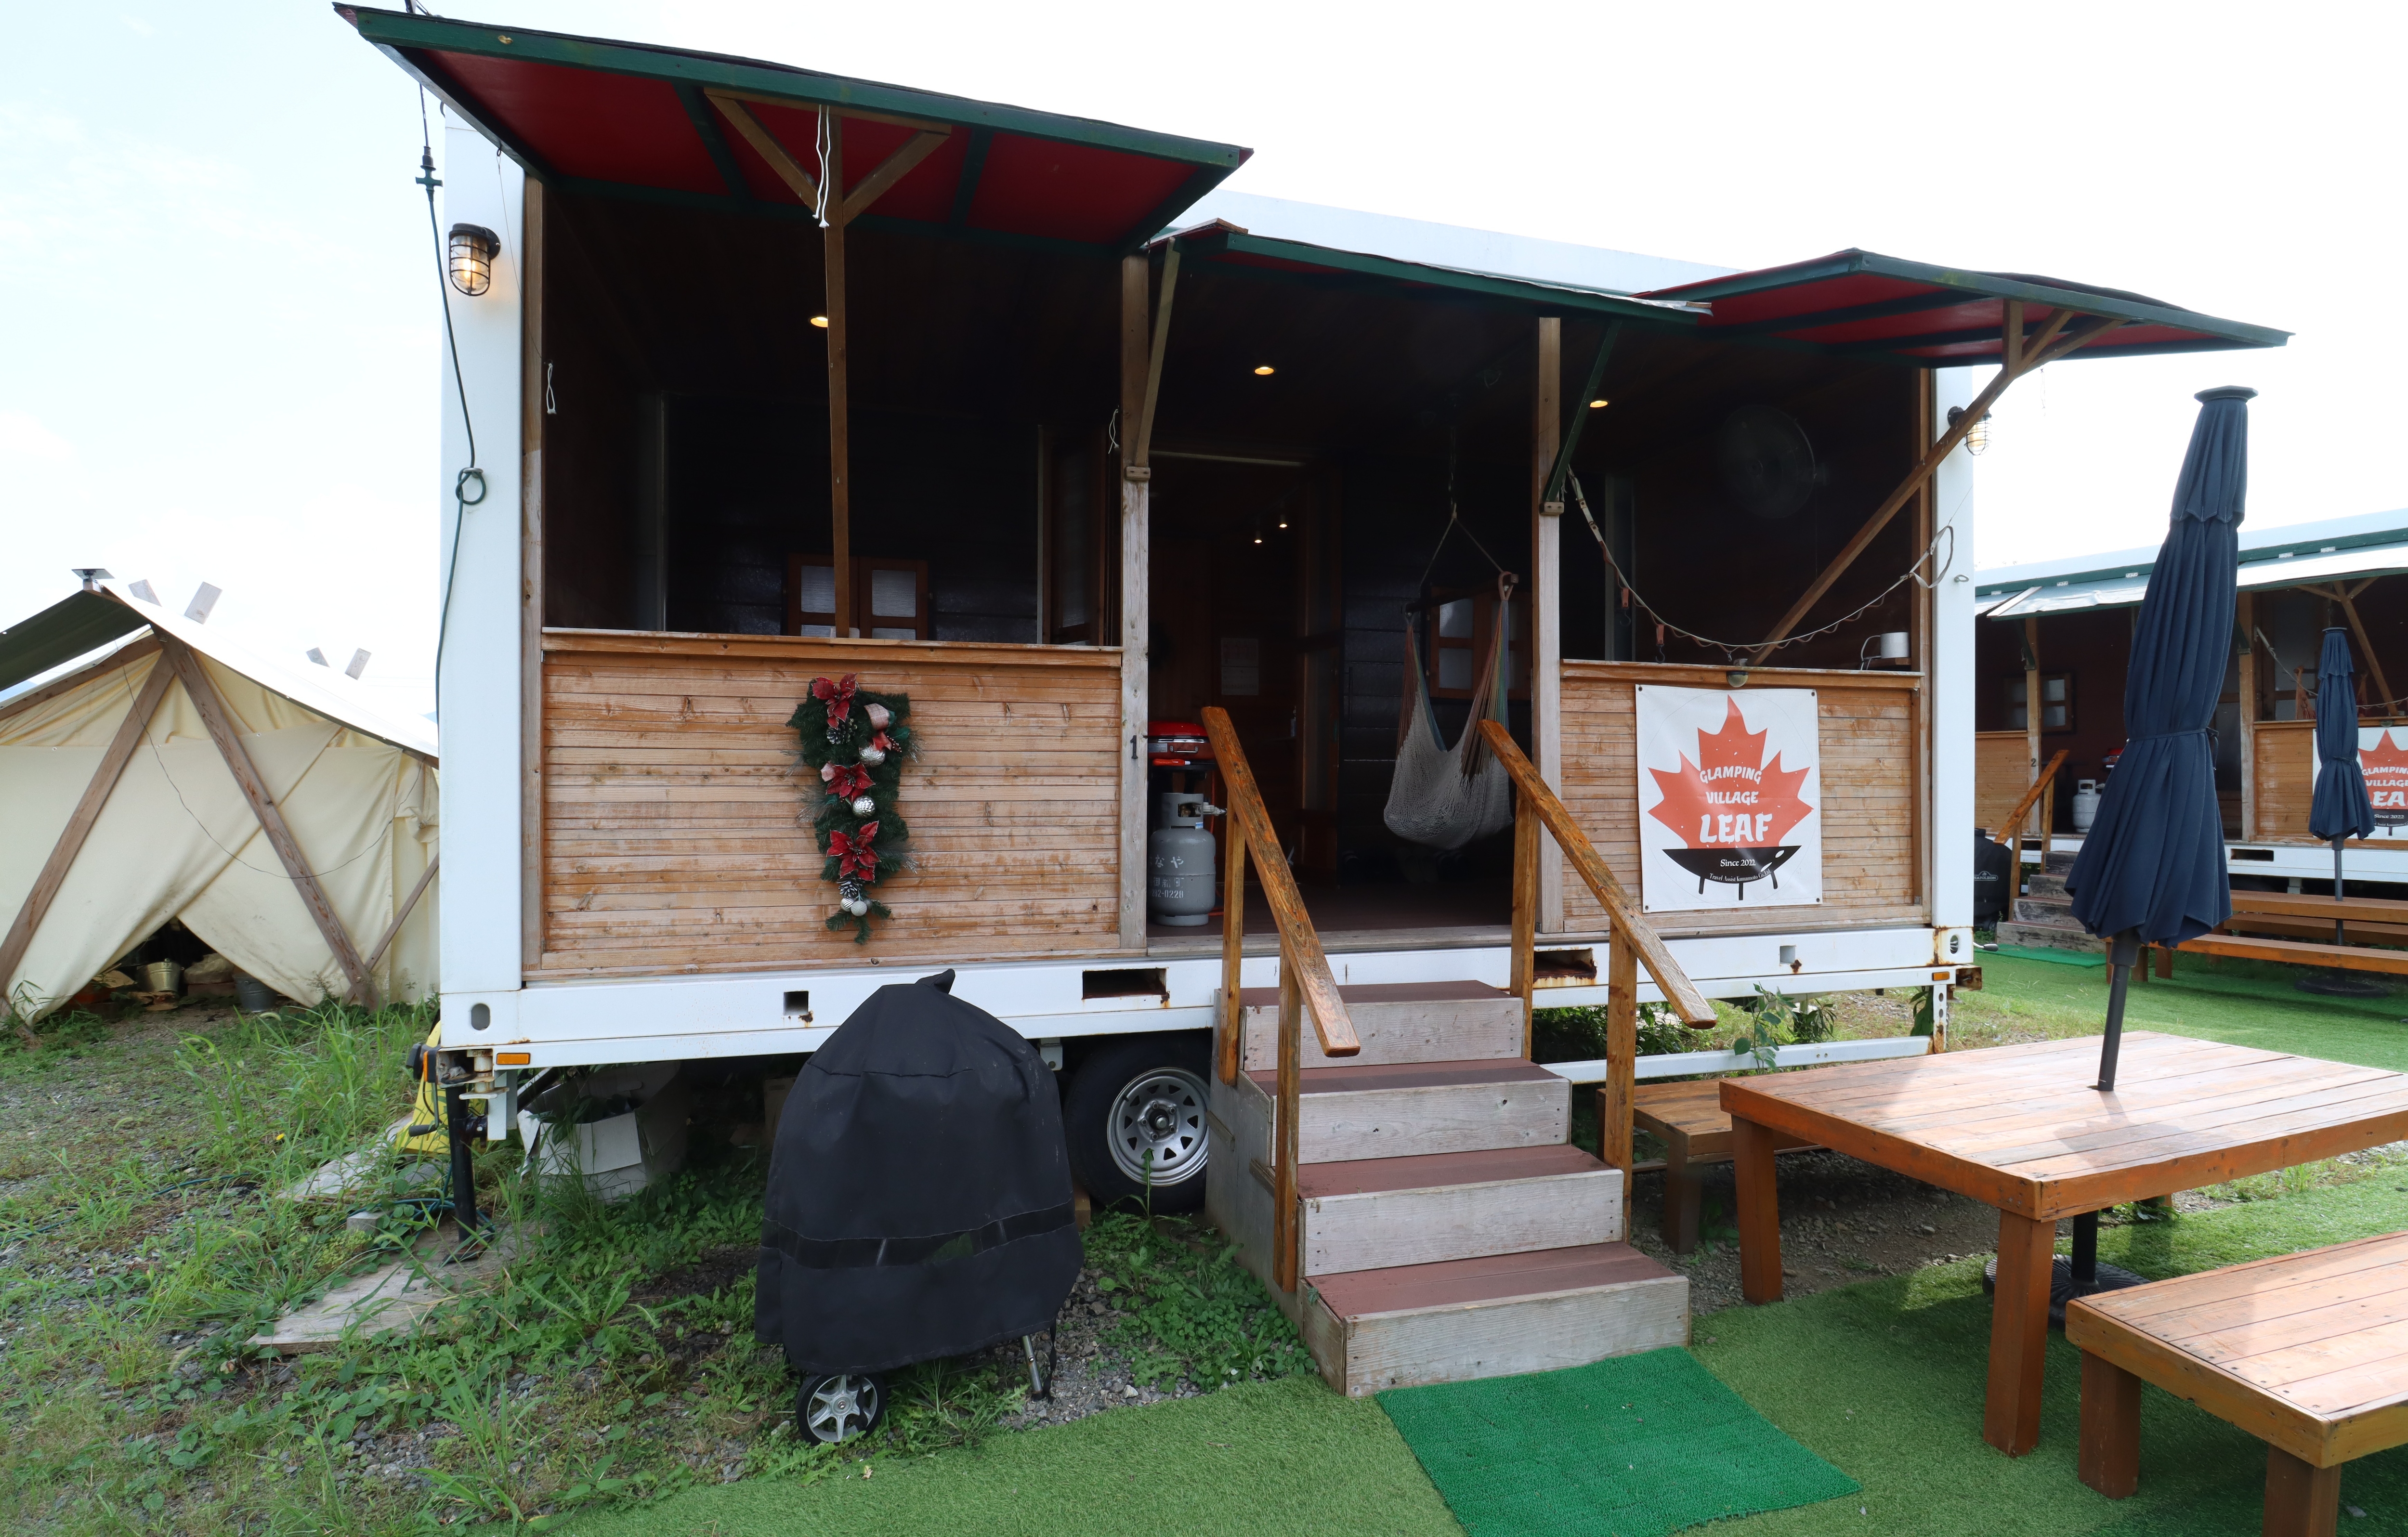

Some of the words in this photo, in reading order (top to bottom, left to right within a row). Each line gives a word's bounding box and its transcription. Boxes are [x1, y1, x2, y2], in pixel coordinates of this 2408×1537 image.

[1130, 735, 1138, 759] 1
[2031, 758, 2036, 767] 2
[1700, 766, 1762, 784] GLAMPING
[2361, 767, 2408, 776] GLAMPIN
[1706, 792, 1759, 806] VILLAGE
[2370, 791, 2408, 807] EA
[1700, 814, 1773, 843] LEAF
[1720, 859, 1740, 867] Since
[1710, 873, 1723, 881] Travel
